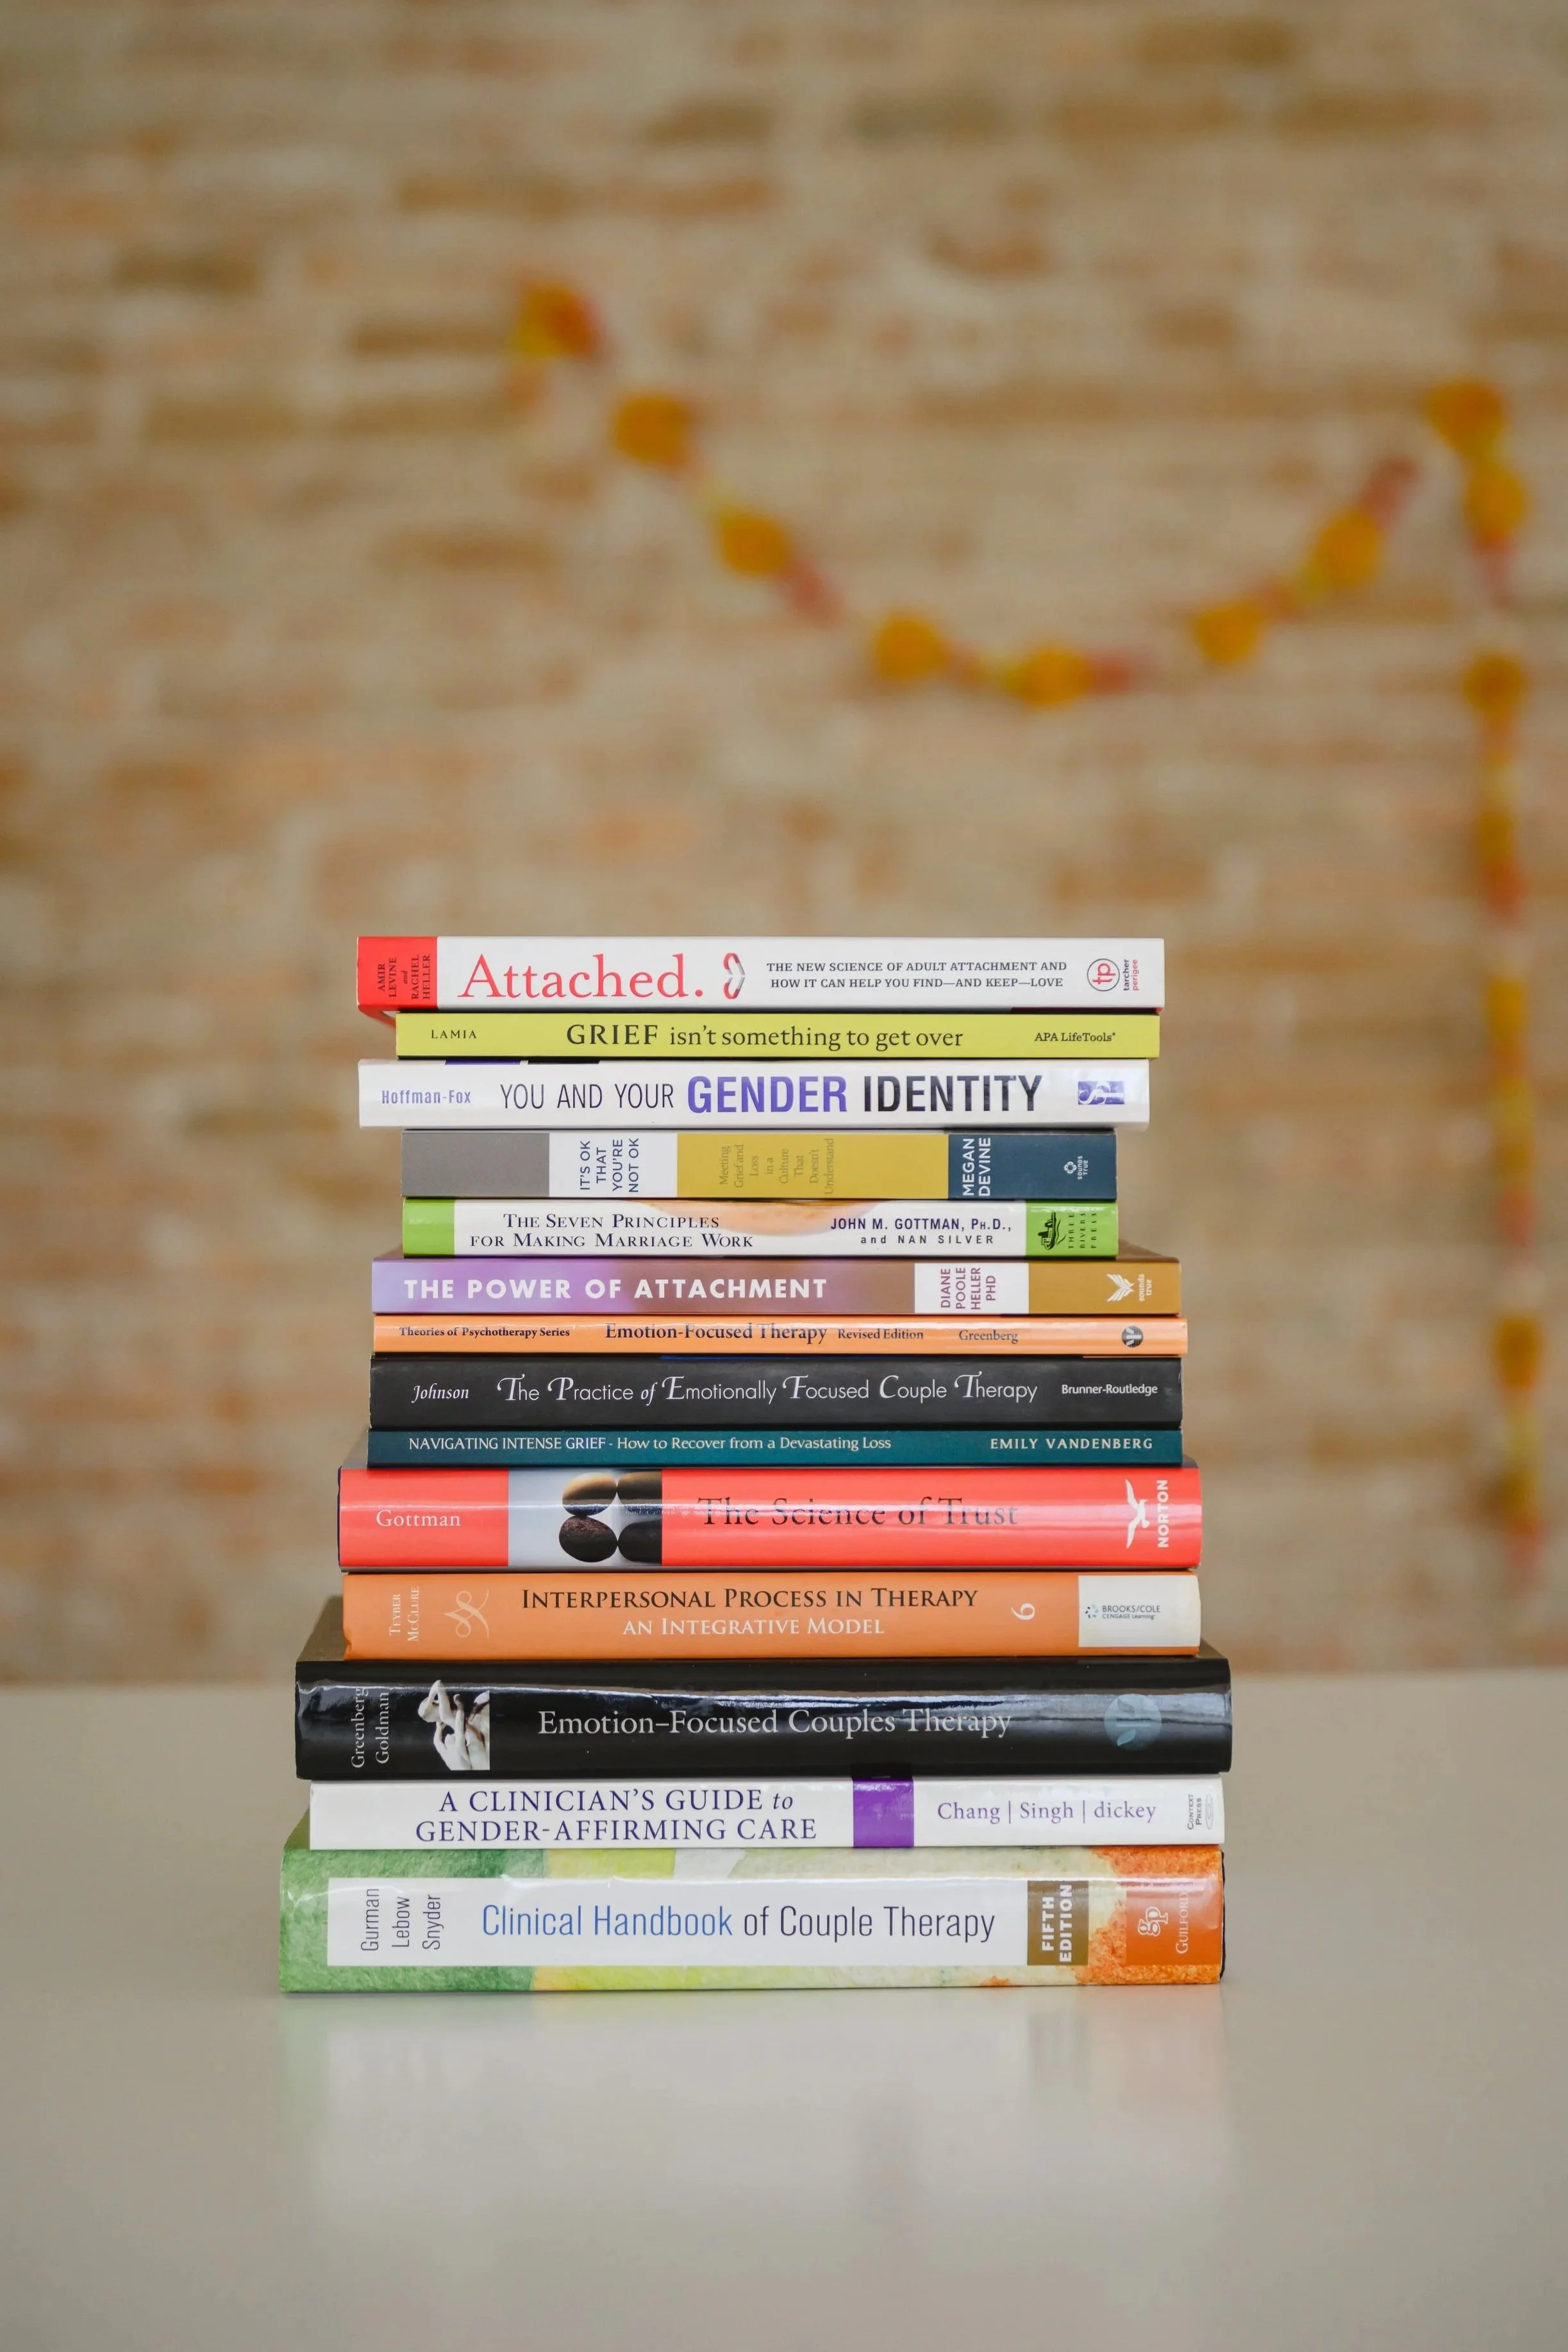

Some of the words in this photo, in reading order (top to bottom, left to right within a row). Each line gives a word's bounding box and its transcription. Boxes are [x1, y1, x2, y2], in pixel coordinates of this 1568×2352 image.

[411, 954, 419, 1000] RACHEL
[422, 955, 431, 1000] HELLER
[458, 953, 703, 998] Attached.
[767, 963, 794, 972] THE
[796, 963, 826, 971] NEW
[829, 962, 883, 971] SCIENCE
[887, 962, 904, 971] OF
[906, 962, 947, 971] ADULT
[950, 962, 1038, 971] ATTACHMENT
[1041, 962, 1067, 971] AND
[1131, 959, 1139, 991] perigee
[771, 978, 801, 988] HOW
[803, 978, 817, 988] IT
[820, 978, 846, 988] CAN
[849, 978, 881, 988] HELP
[884, 978, 910, 987] YOU
[431, 1030, 477, 1039] LAMIA
[567, 1024, 658, 1045] GRIEF
[722, 1026, 840, 1051] something
[847, 1029, 869, 1046] to
[876, 1029, 910, 1051] get
[916, 1032, 963, 1046] over
[1035, 1033, 1058, 1042] APA
[381, 1090, 471, 1105] Hoffman-Fox
[501, 1083, 545, 1108] YOU
[557, 1083, 603, 1108] AND
[614, 1083, 674, 1108] YOUR
[688, 1076, 847, 1113] GENDER
[864, 1075, 1043, 1112] IDENTITY
[580, 1140, 590, 1163] OK
[629, 1138, 639, 1162] OK
[735, 1144, 744, 1163] and
[596, 1147, 607, 1184] THAT
[629, 1165, 639, 1193] NOT
[719, 1146, 731, 1185] Meeting
[733, 1163, 744, 1189] Grief
[749, 1155, 758, 1176] Loss
[765, 1165, 773, 1174] in
[780, 1149, 788, 1184] Culture
[794, 1155, 804, 1177] That
[824, 1138, 834, 1195] Understand
[963, 1138, 974, 1196] MEGAN
[980, 1137, 991, 1196] DEVINE
[831, 1218, 865, 1230] JOHN
[872, 1218, 888, 1230] M.
[894, 1218, 965, 1232] GOTTMAN,
[861, 1235, 887, 1244] and
[897, 1235, 927, 1244] NAN
[938, 1235, 994, 1244] SILVER
[405, 1280, 454, 1298] THE
[467, 1279, 572, 1299] POWER
[585, 1279, 621, 1298] OF
[634, 1279, 826, 1299] ATTACHMENT
[941, 1269, 951, 1308] DIANE
[956, 1267, 966, 1309] POOLE
[971, 1267, 981, 1310] HELLER
[986, 1276, 996, 1301] PHD
[399, 1327, 446, 1337] Theories
[448, 1327, 458, 1337] of
[462, 1326, 537, 1339] Psychotherapy
[540, 1327, 570, 1337] Series
[606, 1322, 753, 1340] Emotion-Focused
[759, 1324, 828, 1344] Therapy
[838, 1329, 881, 1340] Revised
[883, 1329, 923, 1340] Edition
[959, 1330, 1018, 1344] Greenberg
[410, 1384, 469, 1403] Johnson
[497, 1373, 539, 1401] The
[547, 1376, 633, 1401] Practice
[640, 1381, 658, 1406] of
[662, 1376, 776, 1404] Emotionally
[782, 1374, 869, 1399] Focused
[879, 1374, 947, 1403] Couple
[954, 1371, 1038, 1403] Therapy
[1061, 1383, 1158, 1396] Brunner-Routledge
[409, 1437, 499, 1450] NAVIGATING
[503, 1437, 562, 1450] INTENSE
[565, 1437, 606, 1450] GRIEF
[617, 1437, 649, 1449] How
[653, 1439, 668, 1449] to
[672, 1437, 727, 1449] Recover
[730, 1436, 763, 1449] from
[767, 1440, 775, 1449] a
[780, 1437, 859, 1452] Devastating
[862, 1437, 891, 1449] Loss
[990, 1438, 1038, 1449] EMILY
[1046, 1438, 1153, 1449] VANDENBERG
[376, 1510, 460, 1528] Gottman
[696, 1497, 759, 1526] The
[772, 1497, 886, 1526] Science
[898, 1497, 929, 1526] of
[938, 1497, 1017, 1526] Trust
[1157, 1480, 1169, 1548] NORTON
[1103, 1605, 1160, 1613] BROOKS/COLE
[351, 1687, 369, 1768] Greenberg
[375, 1692, 389, 1764] Goldman
[789, 1708, 896, 1739] Couples
[901, 1708, 1011, 1738] Therapy
[438, 1790, 458, 1812] A
[665, 1788, 763, 1811] GUIDE
[772, 1792, 793, 1810] to
[937, 1802, 1000, 1824] Chang
[1019, 1801, 1074, 1823] Singh
[1094, 1801, 1156, 1823] dickey
[415, 1819, 726, 1841] GENDER-AFFIRMING
[737, 1818, 817, 1840] CARE
[360, 1889, 379, 1951] Gurman
[392, 1897, 410, 1948] Lebow
[422, 1894, 444, 1950] Snyder
[483, 1905, 581, 1936] Clinical
[594, 1905, 733, 1936] Handbook
[743, 1906, 769, 1936] of
[780, 1906, 872, 1942] Couple
[883, 1906, 995, 1943] Therapy
[1042, 1896, 1055, 1952] FIFTH
[1059, 1885, 1072, 1963] EDITION
